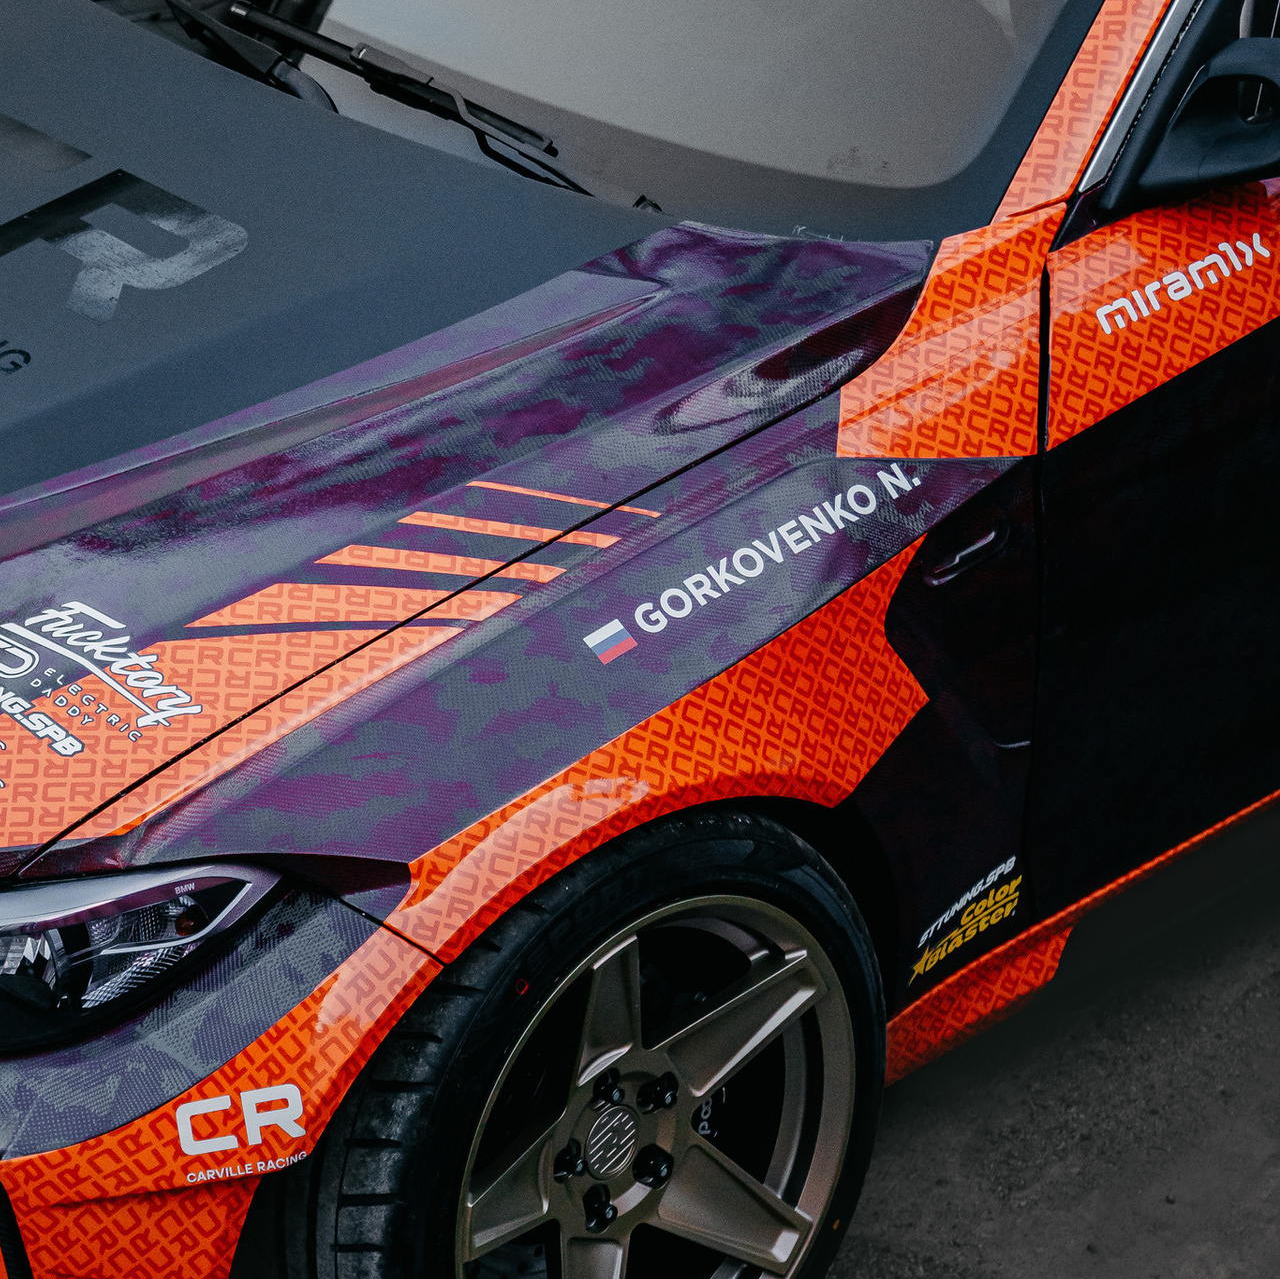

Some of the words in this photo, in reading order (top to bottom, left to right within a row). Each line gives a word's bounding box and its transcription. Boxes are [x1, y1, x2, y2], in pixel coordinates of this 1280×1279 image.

[1096, 231, 1272, 335] miramix
[633, 484, 879, 634] GORKOVENKO
[874, 462, 923, 501] N.
[30, 678, 93, 726] DADDY
[43, 667, 143, 742] ELECTRIC
[174, 882, 196, 895] BMW
[917, 854, 1017, 949] STTUNING.SPB
[960, 874, 1023, 926] Color
[924, 896, 1019, 972] Blaster
[176, 1083, 307, 1156] CR
[186, 1162, 254, 1184] CARVILLE
[256, 1151, 308, 1173] RACING
